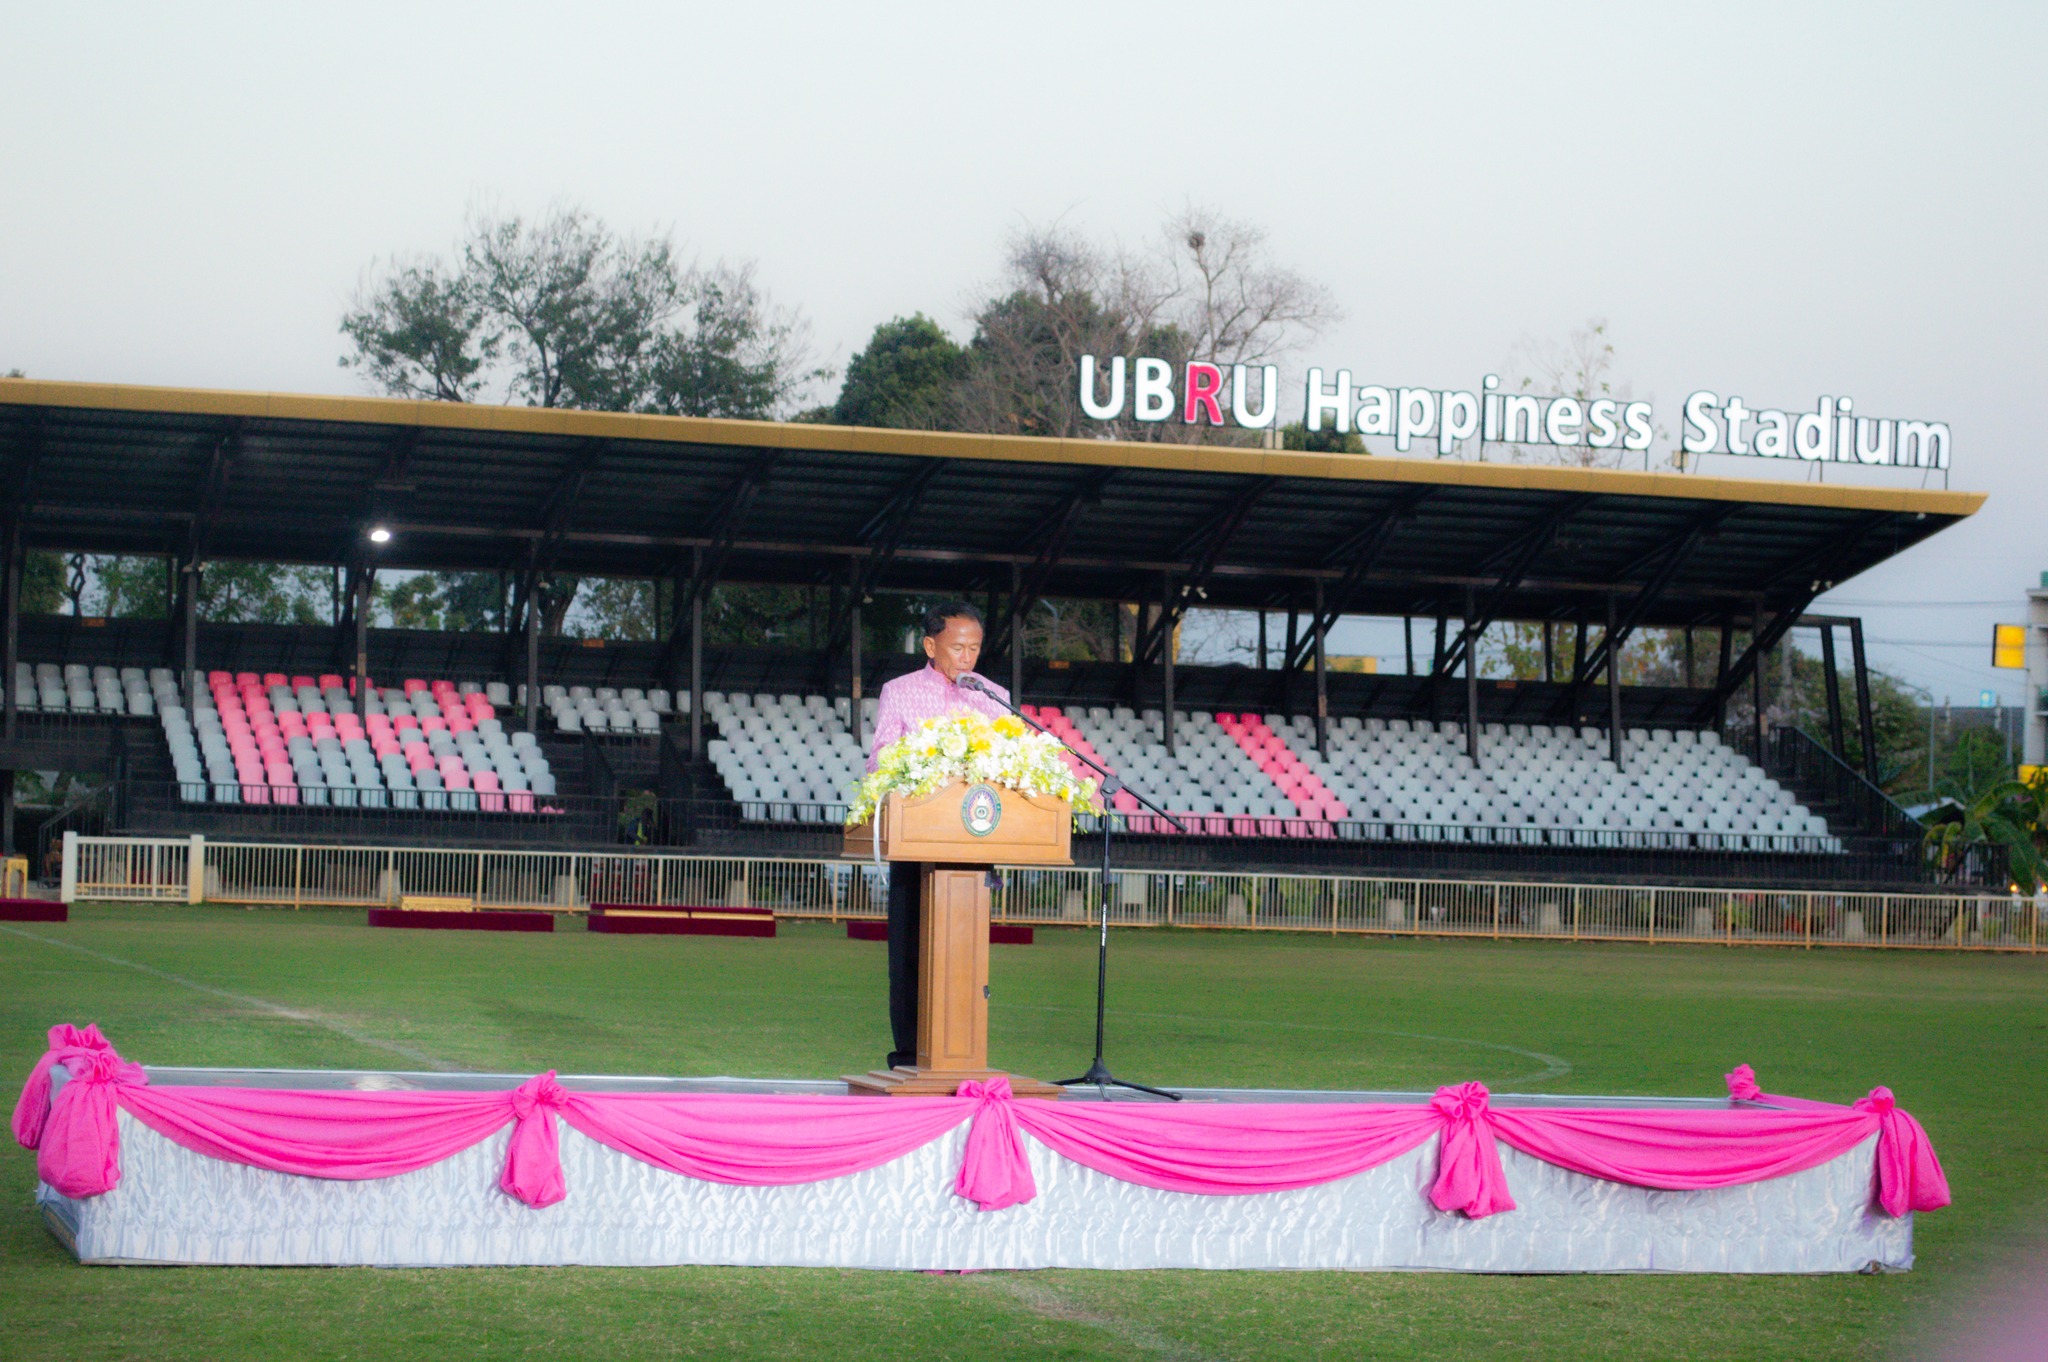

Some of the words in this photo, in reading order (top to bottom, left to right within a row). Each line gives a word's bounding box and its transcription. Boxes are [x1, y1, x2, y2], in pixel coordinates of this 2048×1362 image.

[1080, 354, 1278, 428] UBRU
[1307, 367, 1653, 455] Happiness
[1683, 390, 1952, 470] Stadium
